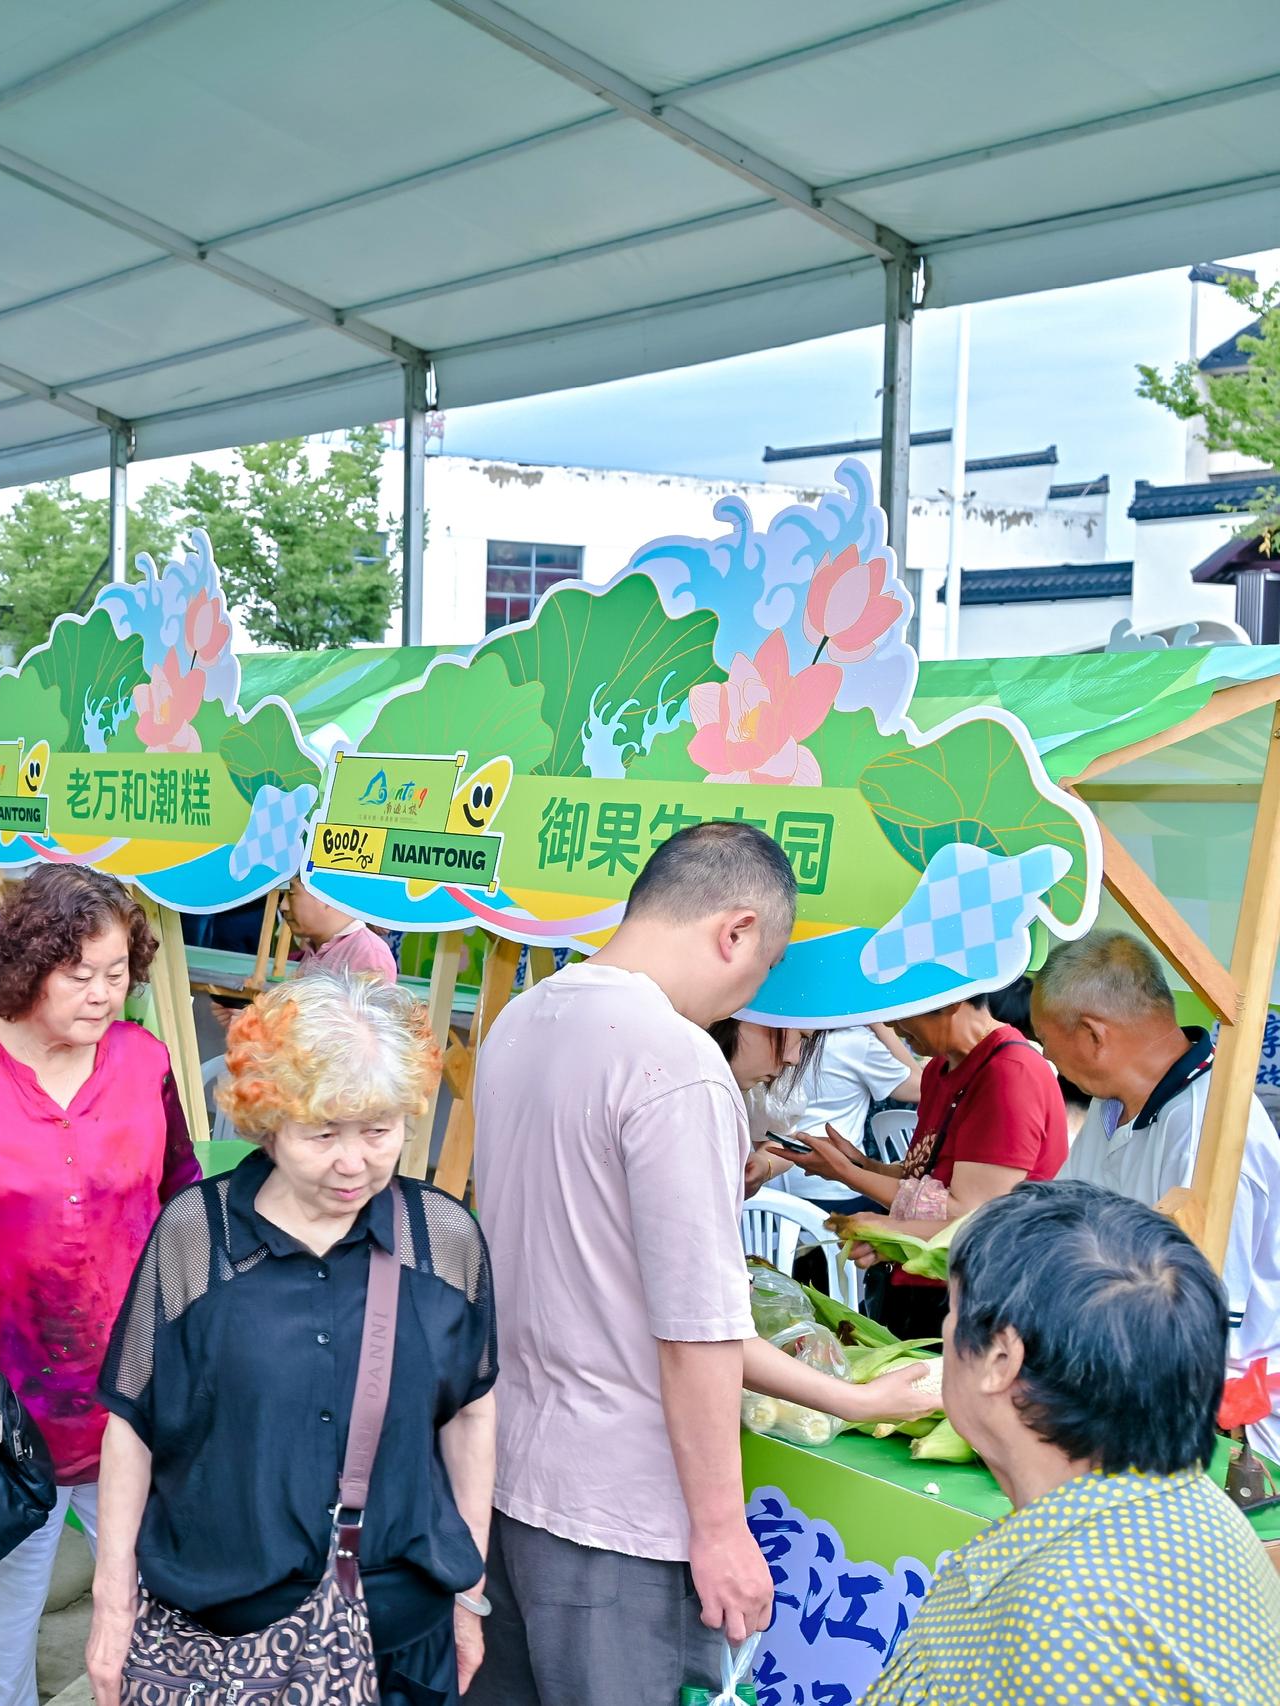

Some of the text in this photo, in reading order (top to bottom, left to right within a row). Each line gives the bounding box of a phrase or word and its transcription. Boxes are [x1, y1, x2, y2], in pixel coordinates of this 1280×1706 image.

[66, 767, 211, 826] 老万和潮糕
[322, 828, 487, 871] GOOD! NANTONG
[538, 797, 835, 896] 御果园
[365, 1311, 391, 1401] DANNI
